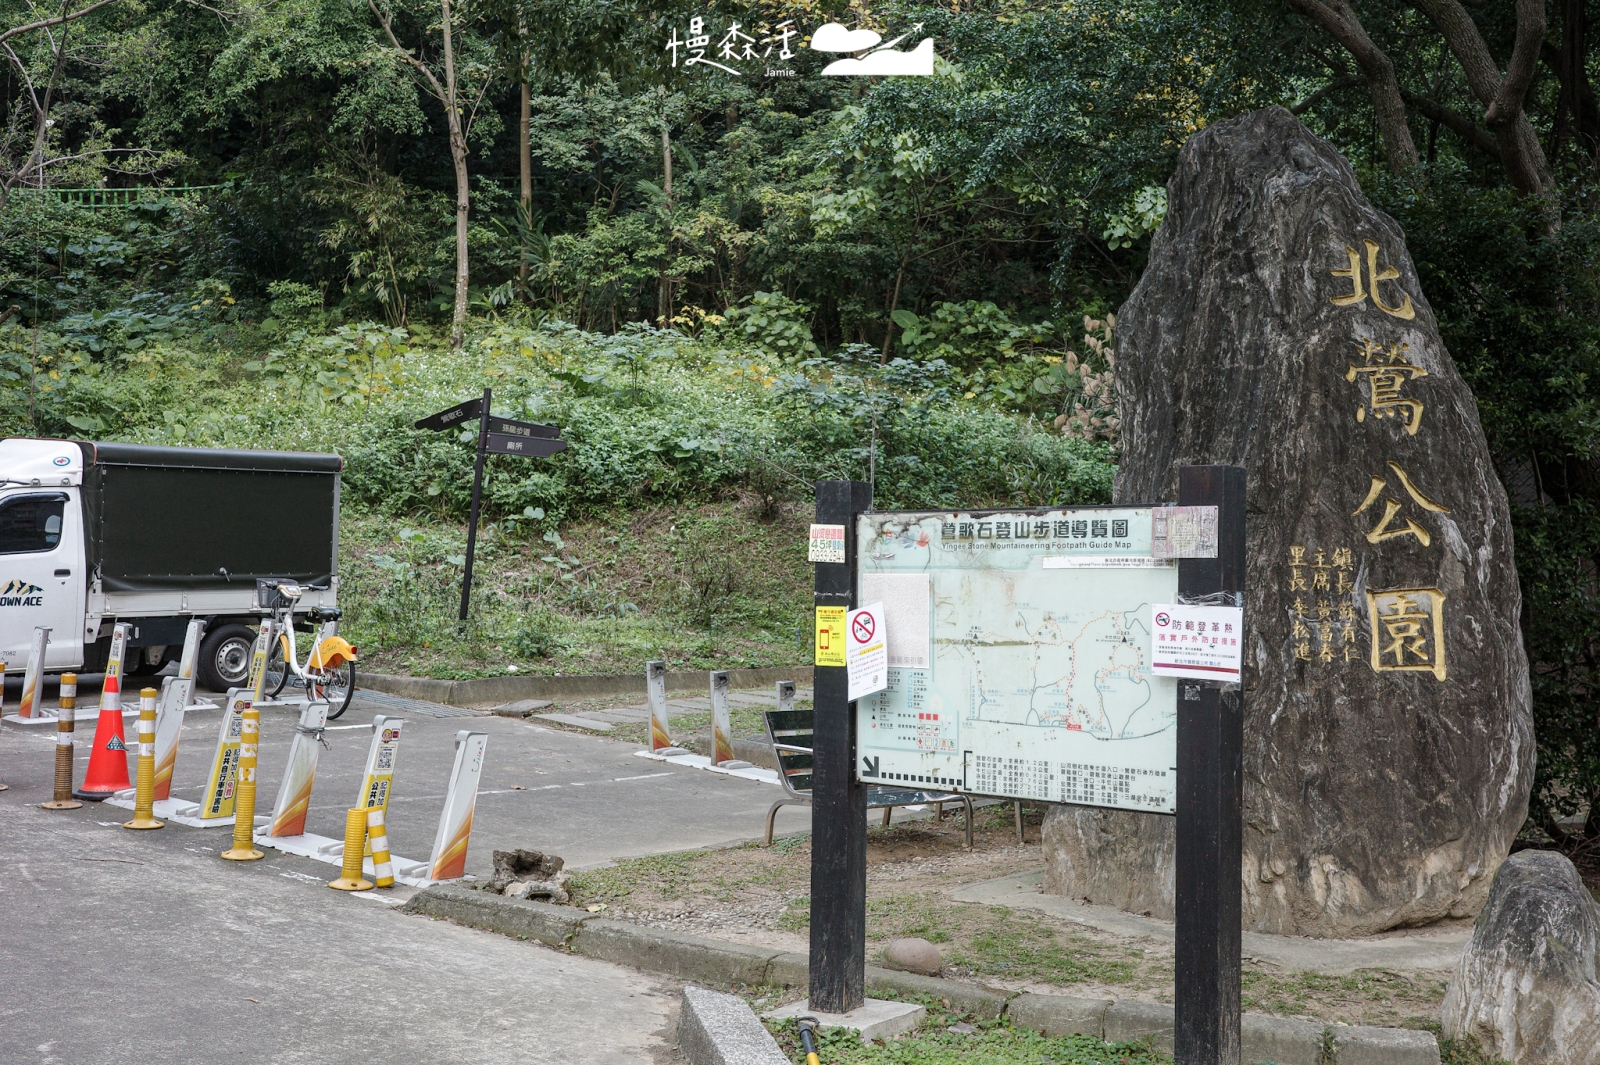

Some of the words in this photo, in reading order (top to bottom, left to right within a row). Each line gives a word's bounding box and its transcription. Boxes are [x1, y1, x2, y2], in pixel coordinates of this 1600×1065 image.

[506, 441, 523, 451] 廁所
[1329, 238, 1451, 682] 北鶯公園
[967, 542, 989, 550] Stone
[990, 542, 1050, 551] Mountaineering
[1052, 541, 1087, 550] Footpath
[1089, 541, 1112, 549] Guide
[1115, 541, 1132, 550] Map
[1288, 545, 1308, 592] 里長
[1309, 546, 1332, 592] 主席
[22, 597, 43, 607] ACE
[1172, 619, 1233, 634] 防範登革熱
[1158, 633, 1237, 647] 落實戶外防蚊措施
